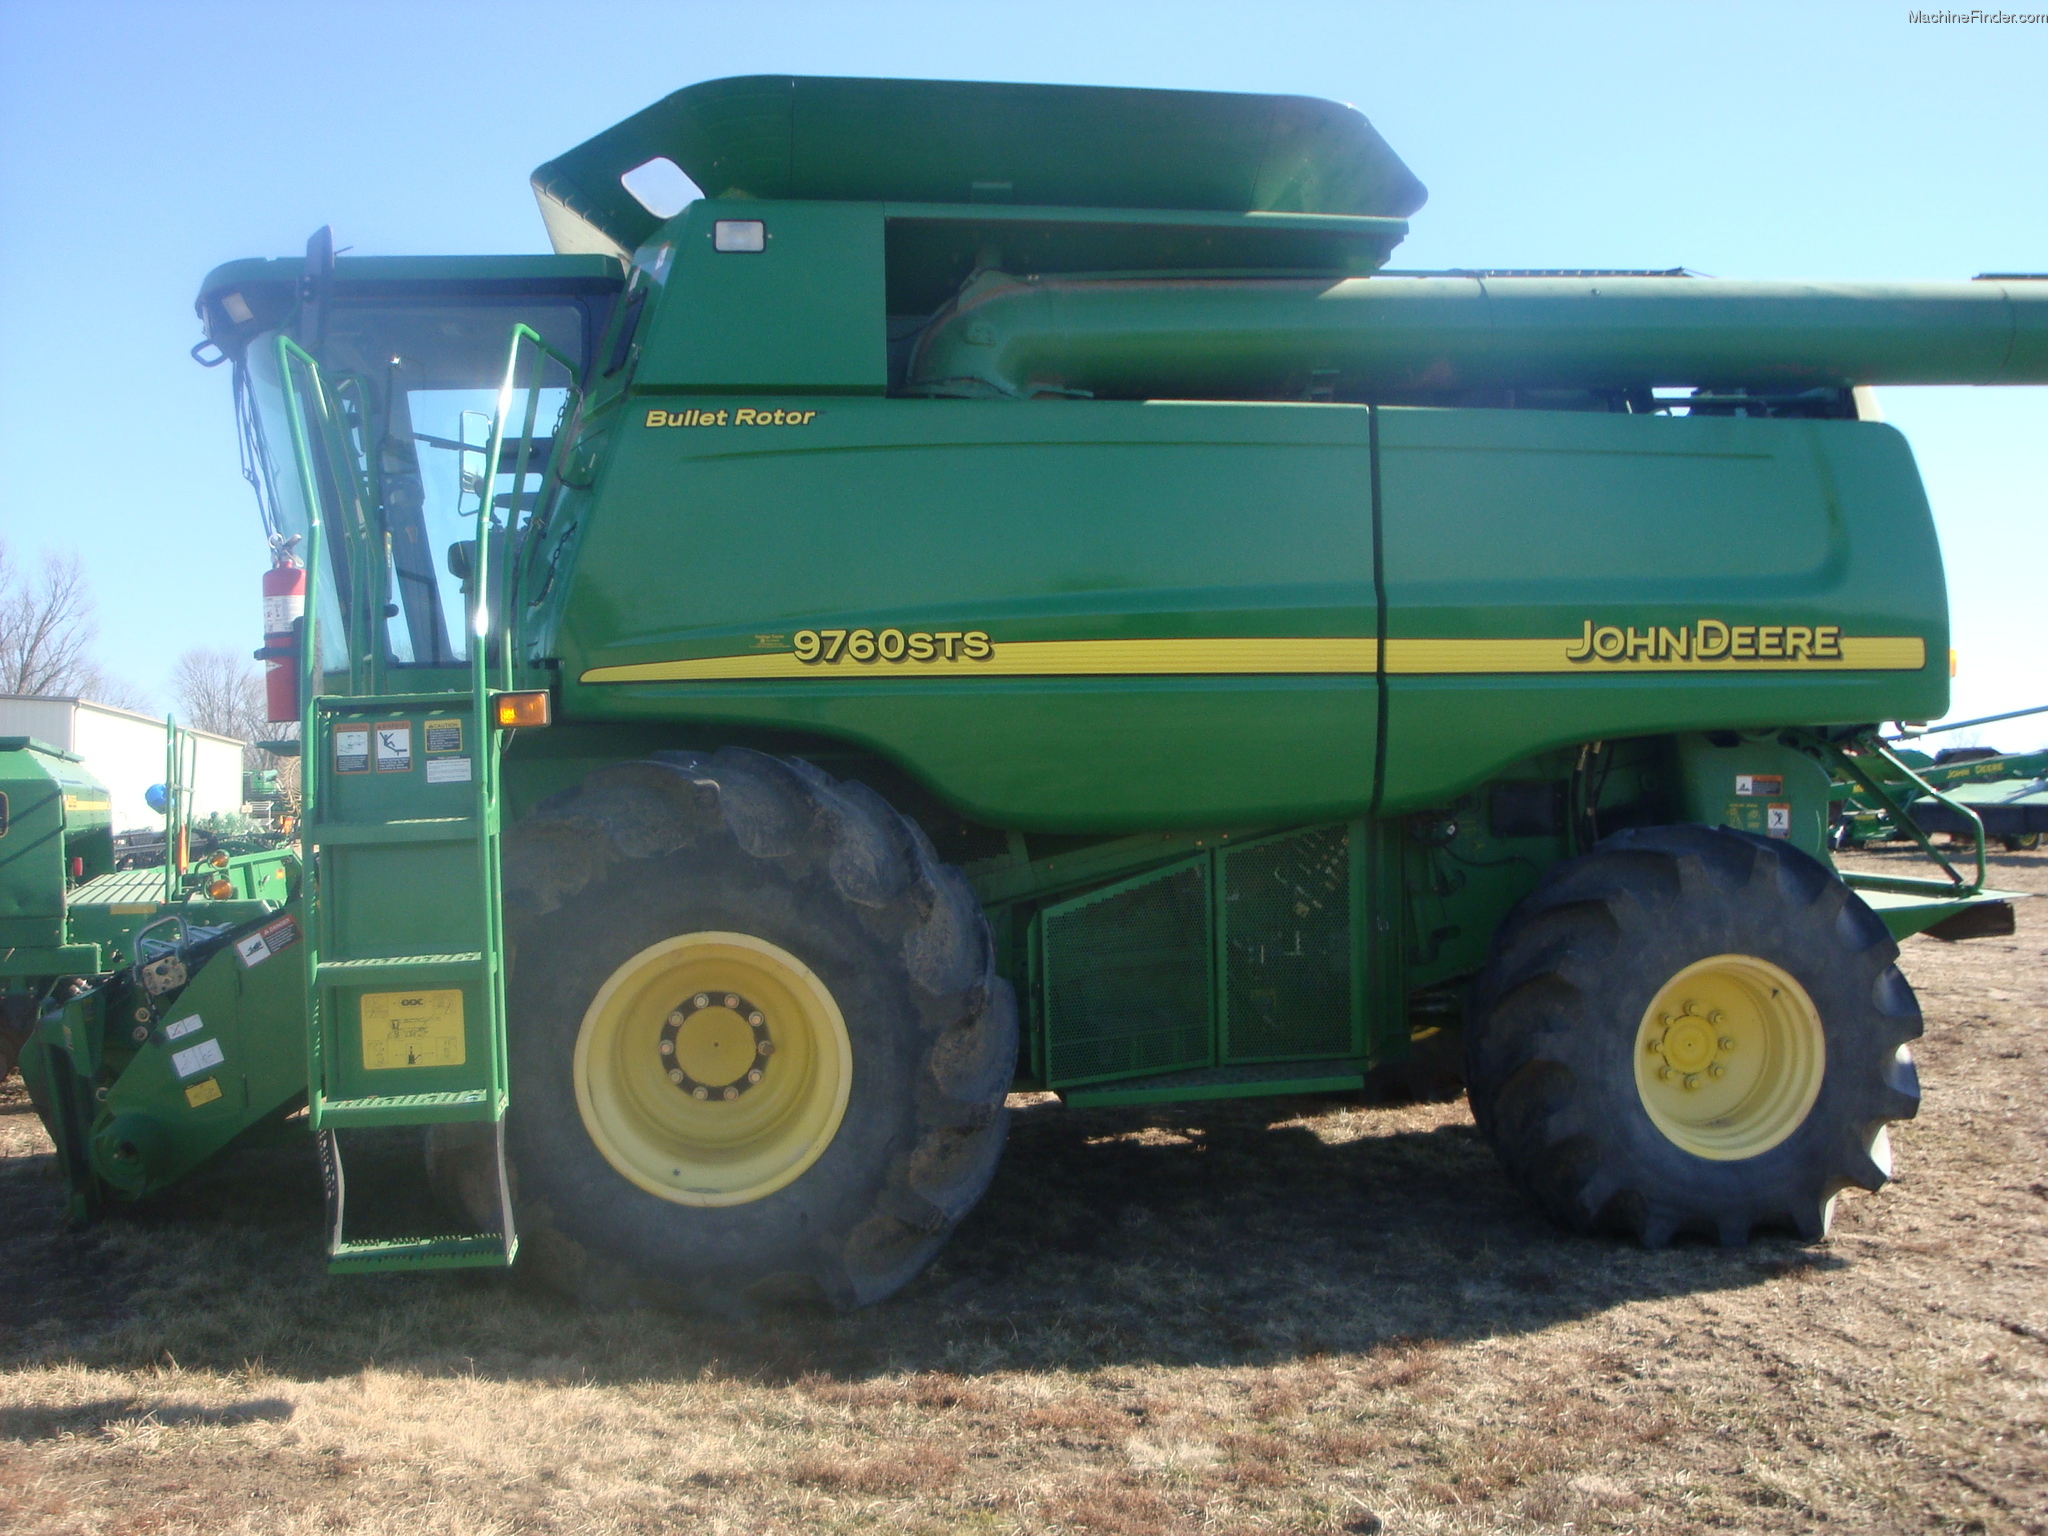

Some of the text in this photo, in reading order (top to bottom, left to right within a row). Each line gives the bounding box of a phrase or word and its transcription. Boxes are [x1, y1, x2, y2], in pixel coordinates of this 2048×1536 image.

[645, 408, 817, 428] Bullet Rotor
[793, 628, 994, 664] 9760STS
[1566, 618, 1843, 662] JOHN DEERE
[1946, 762, 2004, 779] JOHN DEERE
